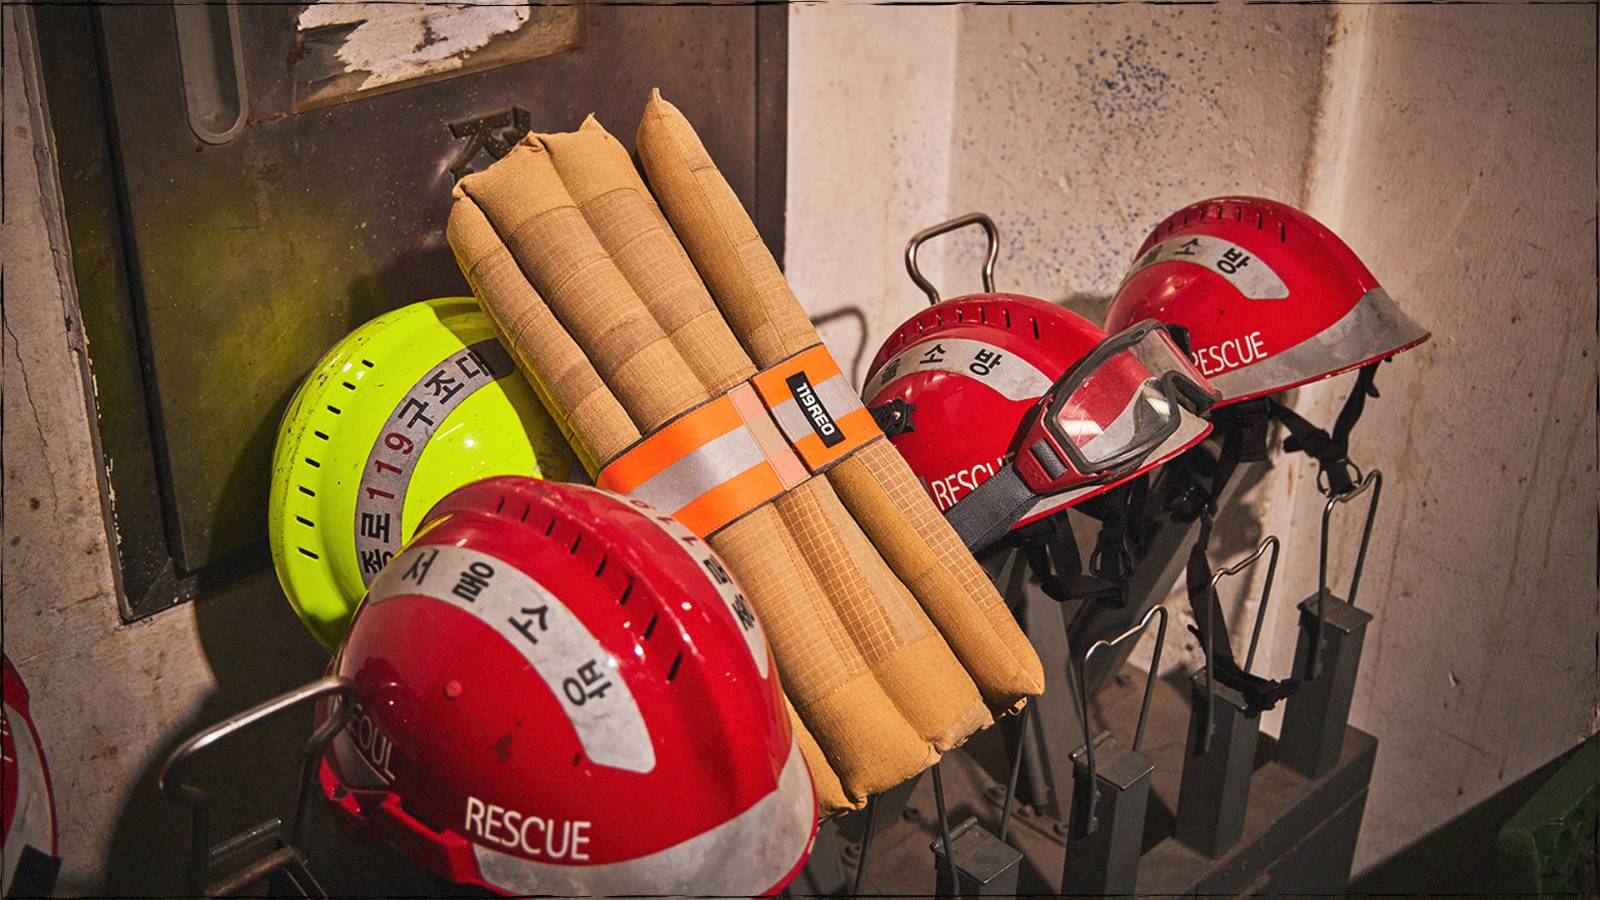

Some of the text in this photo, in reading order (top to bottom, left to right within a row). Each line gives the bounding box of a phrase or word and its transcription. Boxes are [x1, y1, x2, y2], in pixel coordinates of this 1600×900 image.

[796, 382, 835, 436] 119REO
[931, 452, 1015, 511] RESC
[465, 796, 592, 860] RESCUE
